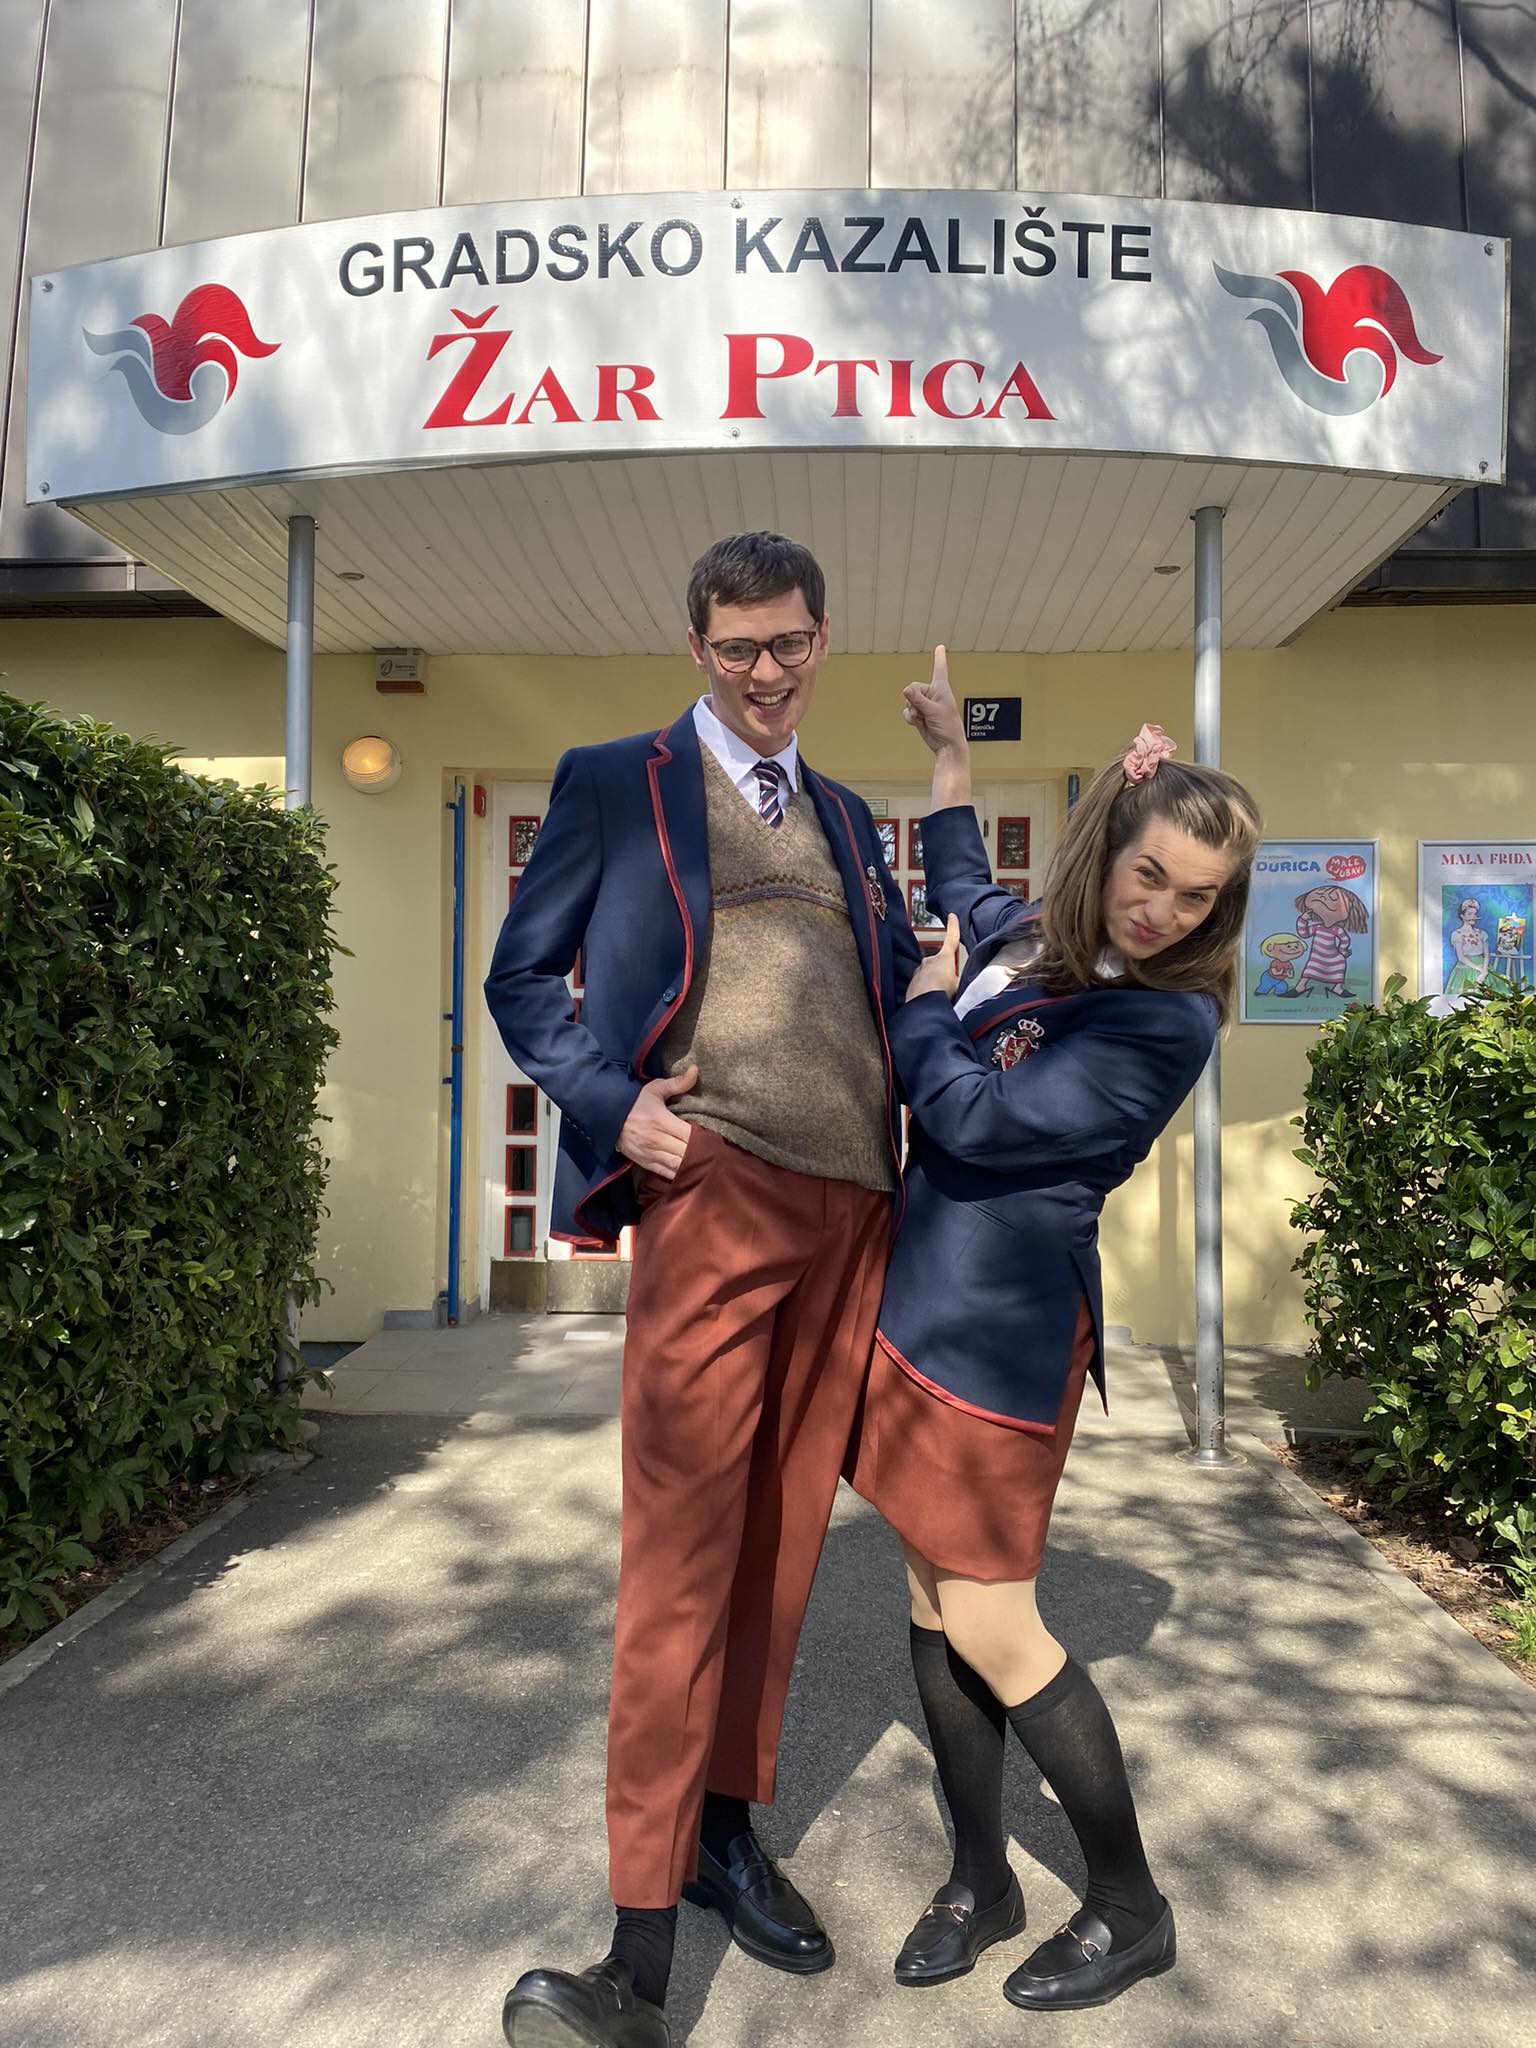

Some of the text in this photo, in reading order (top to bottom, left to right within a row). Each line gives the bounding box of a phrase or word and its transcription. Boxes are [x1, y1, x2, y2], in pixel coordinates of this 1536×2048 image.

[339, 206, 1152, 297] GRADSKO KAZALIŠTE
[971, 704, 999, 722] 97
[1331, 858, 1360, 867] MALE
[1441, 853, 1533, 865] MALA FRIDA
[1256, 861, 1321, 873] DURICA
